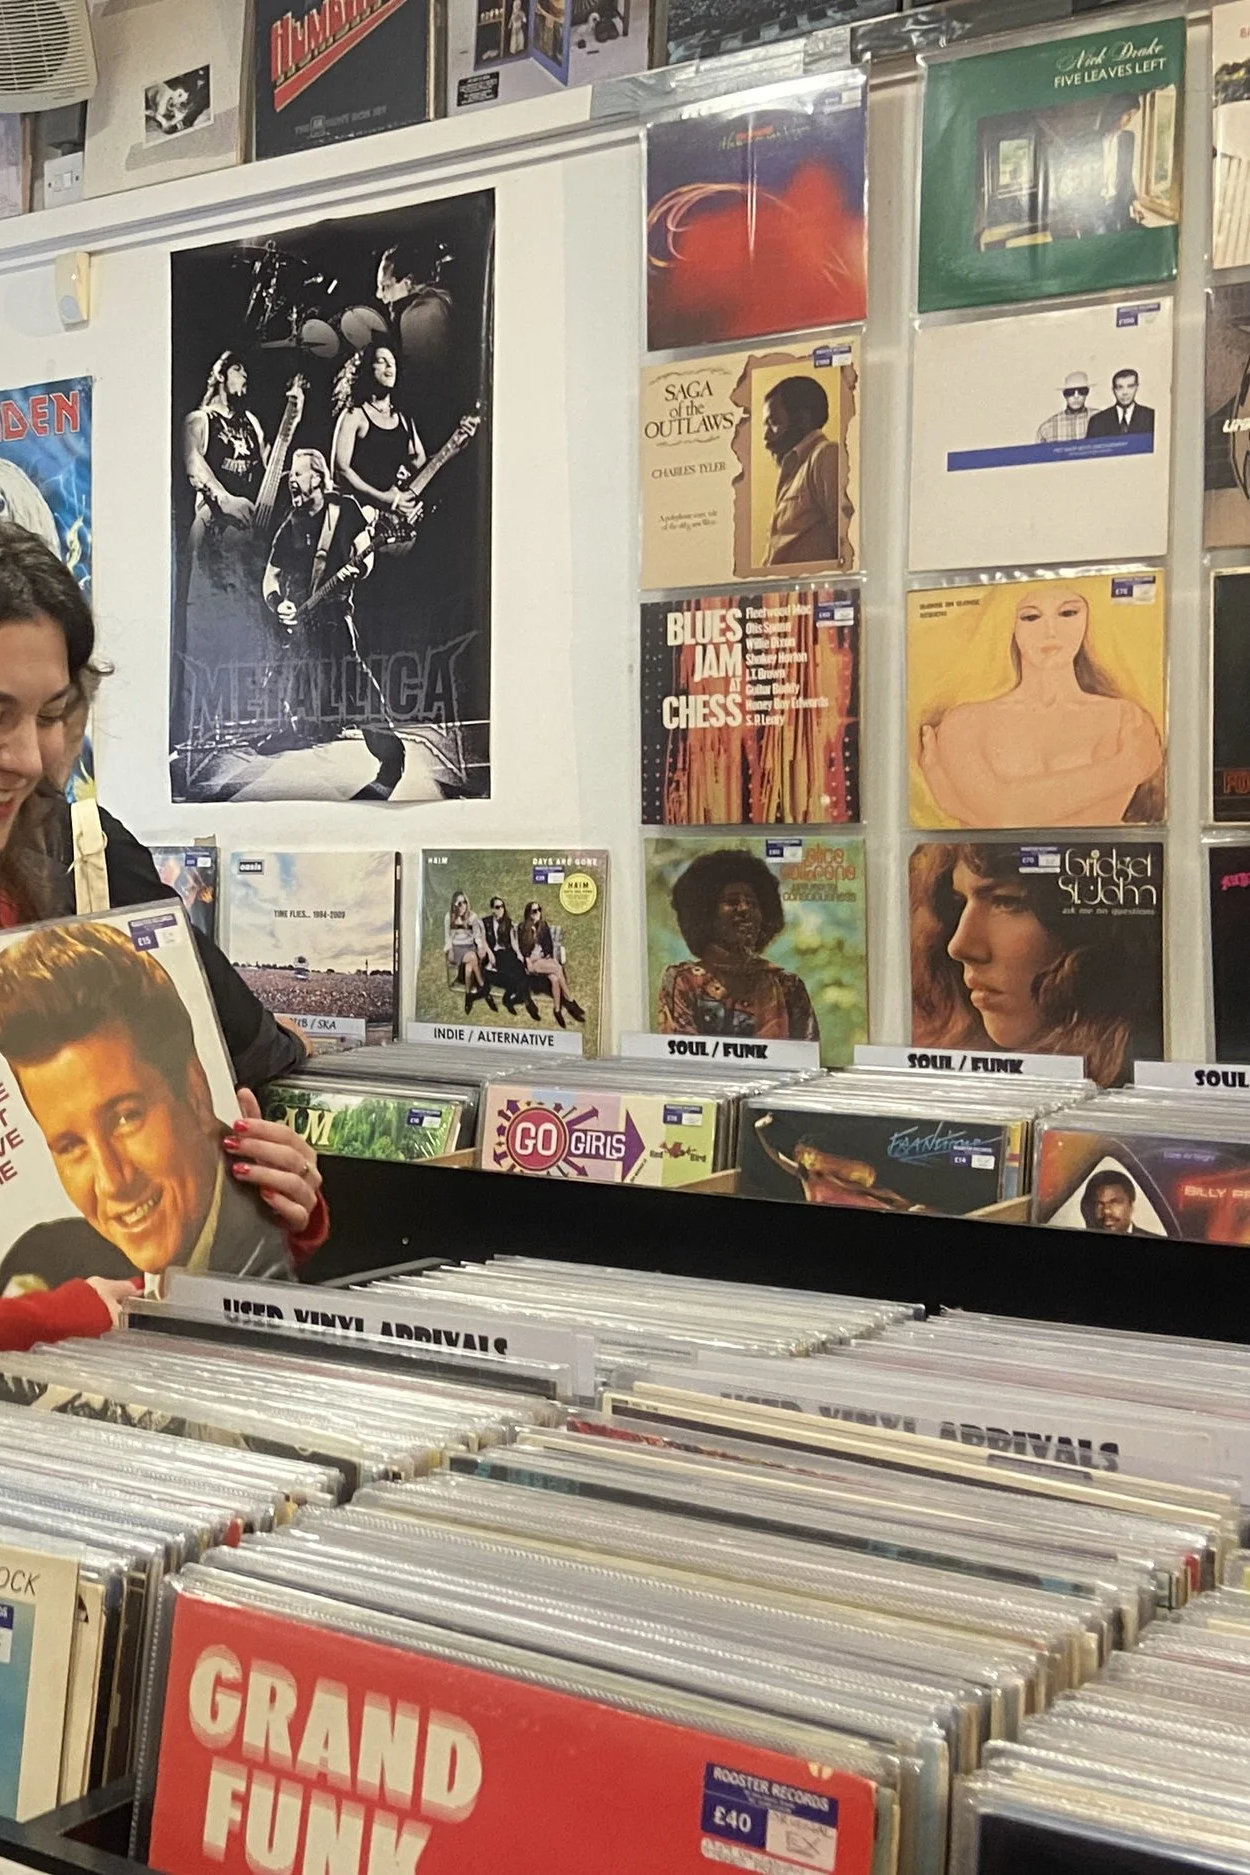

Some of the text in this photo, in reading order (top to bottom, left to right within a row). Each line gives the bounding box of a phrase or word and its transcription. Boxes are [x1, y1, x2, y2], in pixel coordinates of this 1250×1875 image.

[1054, 57, 1167, 88] FIVE LEAVES LEFT
[664, 380, 714, 403] SAGA
[669, 400, 705, 419] of the
[645, 412, 735, 440] OUTLAWS
[651, 462, 726, 480] CHARLES TYLER
[666, 608, 743, 646] BLUES
[694, 643, 743, 682] JAM
[729, 678, 741, 693] AT
[662, 693, 743, 730] CHESS
[239, 861, 263, 872] oasis
[532, 857, 598, 867] DAYS ARE GONE
[273, 909, 289, 919] TIME
[317, 1018, 337, 1031] SKA
[433, 1026, 465, 1042] INDIE
[476, 1029, 555, 1047] ALTERNATIVE
[667, 1040, 710, 1057] SOUL
[722, 1042, 768, 1060] FUNK
[907, 1053, 952, 1071] SOUL
[970, 1056, 1024, 1075] FUNK
[1194, 1069, 1250, 1089] SOUL
[514, 1121, 627, 1160] GO GIRLS
[1184, 1185, 1227, 1199] BILLY
[188, 1644, 483, 1826] GRAND
[713, 1766, 830, 1813] ROOSTER RECORDS
[202, 1755, 434, 1875] FUNK
[713, 1805, 752, 1833] £40
